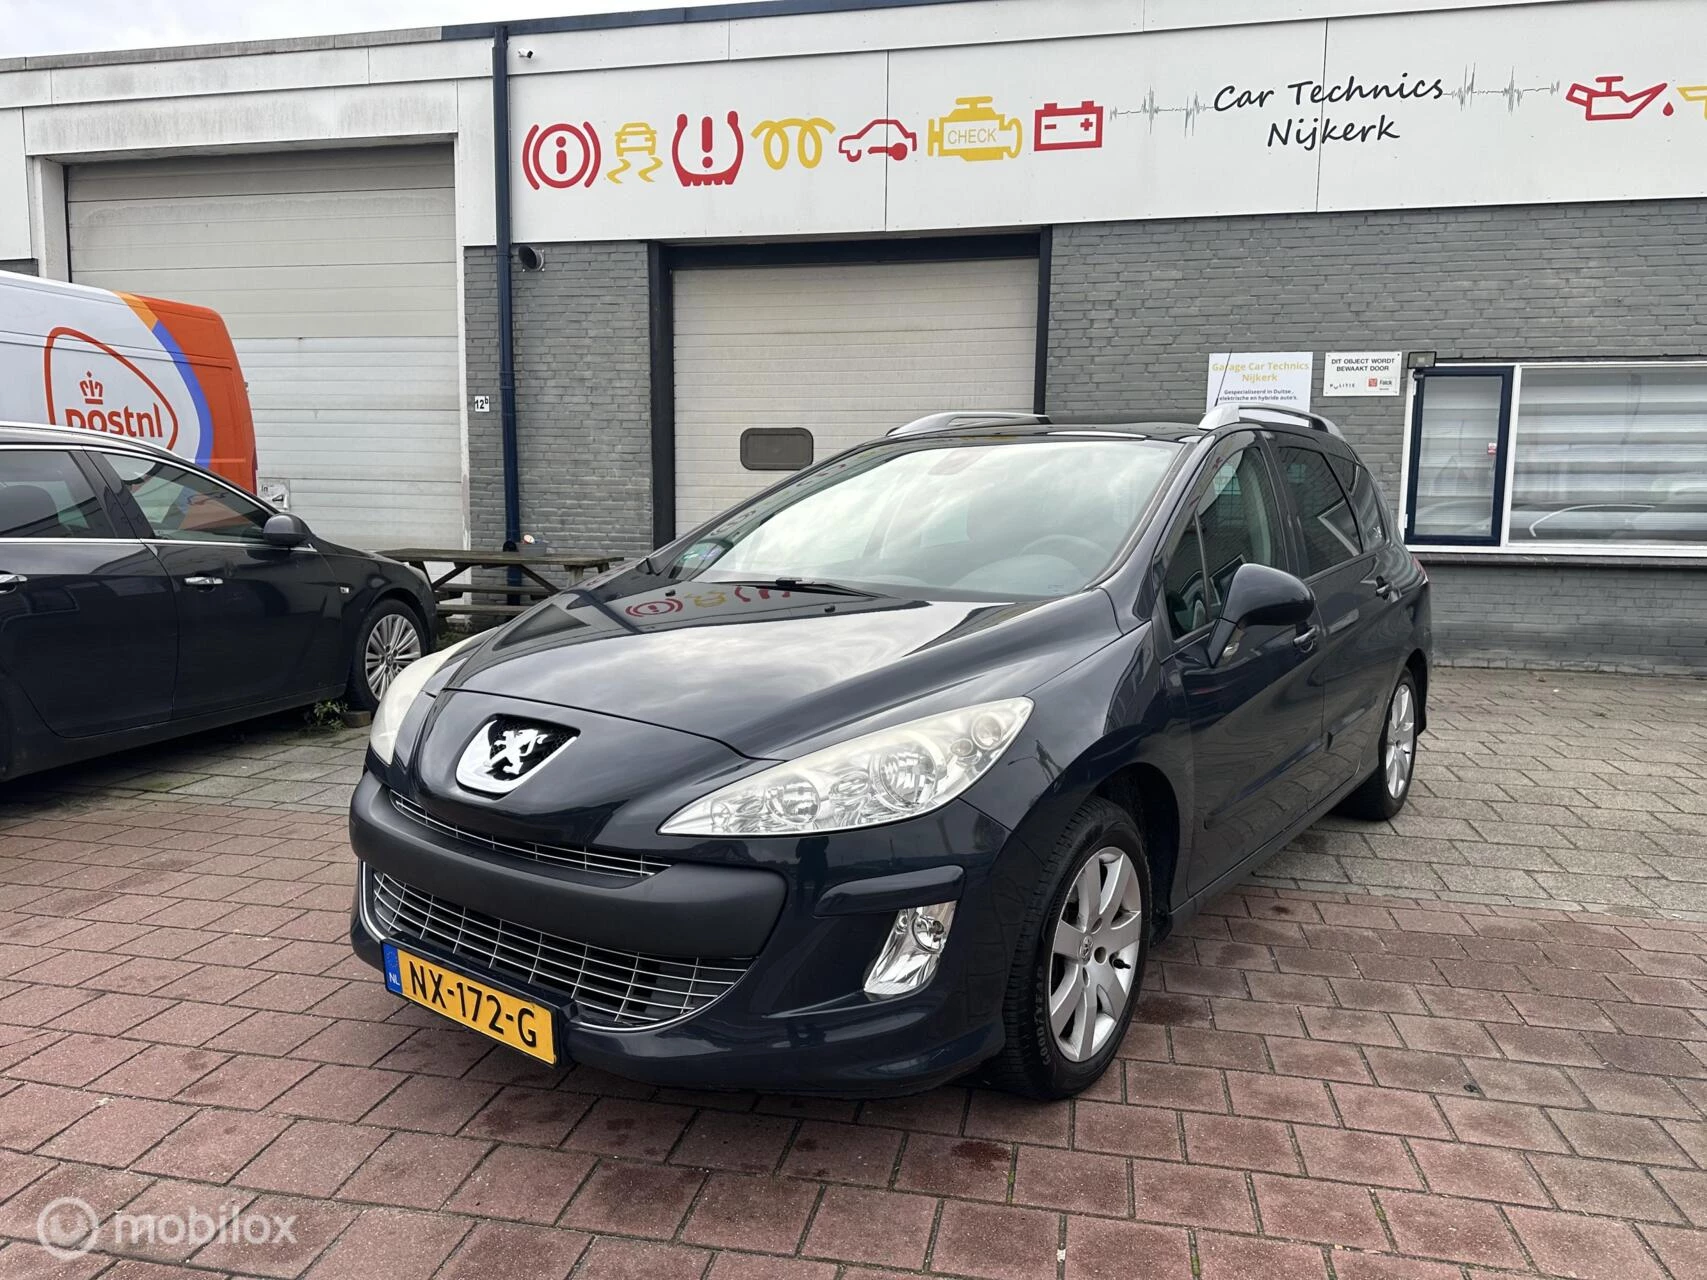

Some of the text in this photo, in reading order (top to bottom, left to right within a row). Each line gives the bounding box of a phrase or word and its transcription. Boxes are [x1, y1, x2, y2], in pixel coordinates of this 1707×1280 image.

[1213, 72, 1444, 112] Car Technics
[947, 128, 998, 145] CHECK
[1267, 114, 1401, 151] Nijkerk
[1211, 361, 1310, 373] Garage Car Technics
[1242, 373, 1279, 383] Nijkerk
[388, 973, 400, 986] NL
[409, 960, 537, 1048] NX-172-G
